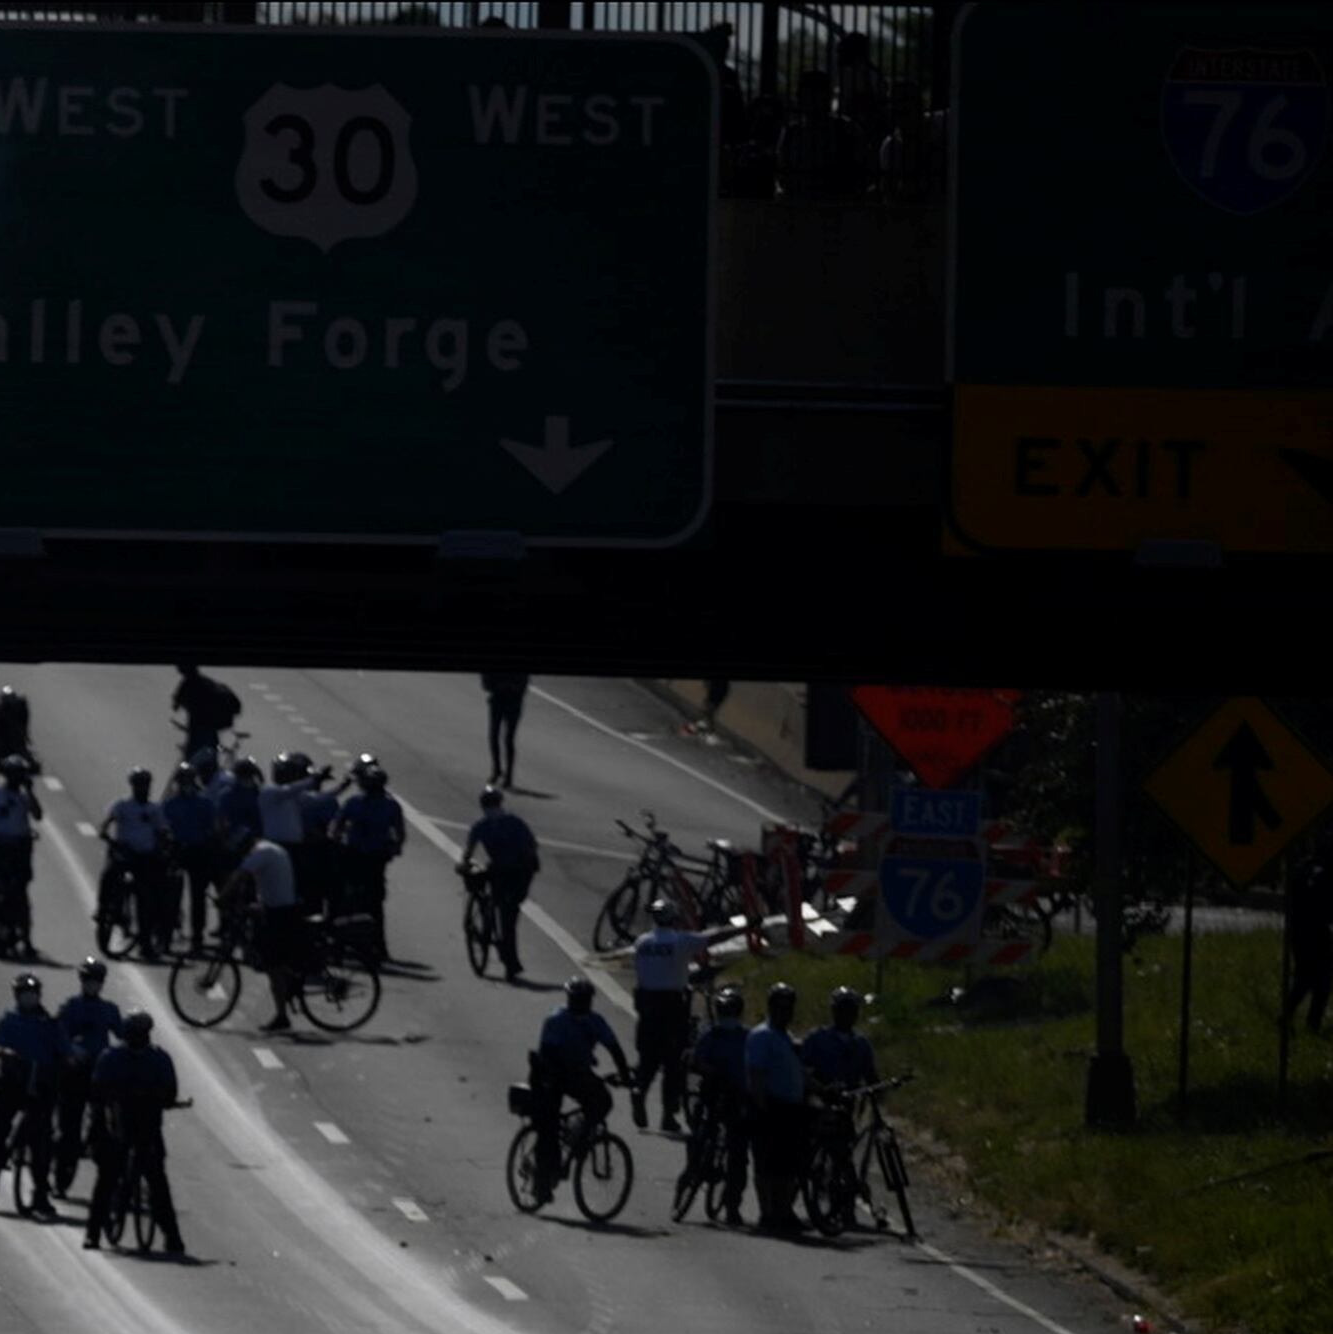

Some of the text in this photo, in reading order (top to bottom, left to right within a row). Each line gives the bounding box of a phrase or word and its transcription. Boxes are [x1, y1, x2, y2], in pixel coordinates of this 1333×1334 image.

[466, 83, 668, 147] WEST
[1180, 89, 1308, 182] 76
[259, 114, 395, 205] 30
[1062, 270, 1247, 339] Int'l
[267, 300, 532, 394] Forge
[1014, 437, 1206, 499] EXIT
[901, 794, 966, 829] EAST
[896, 868, 966, 921] 76
